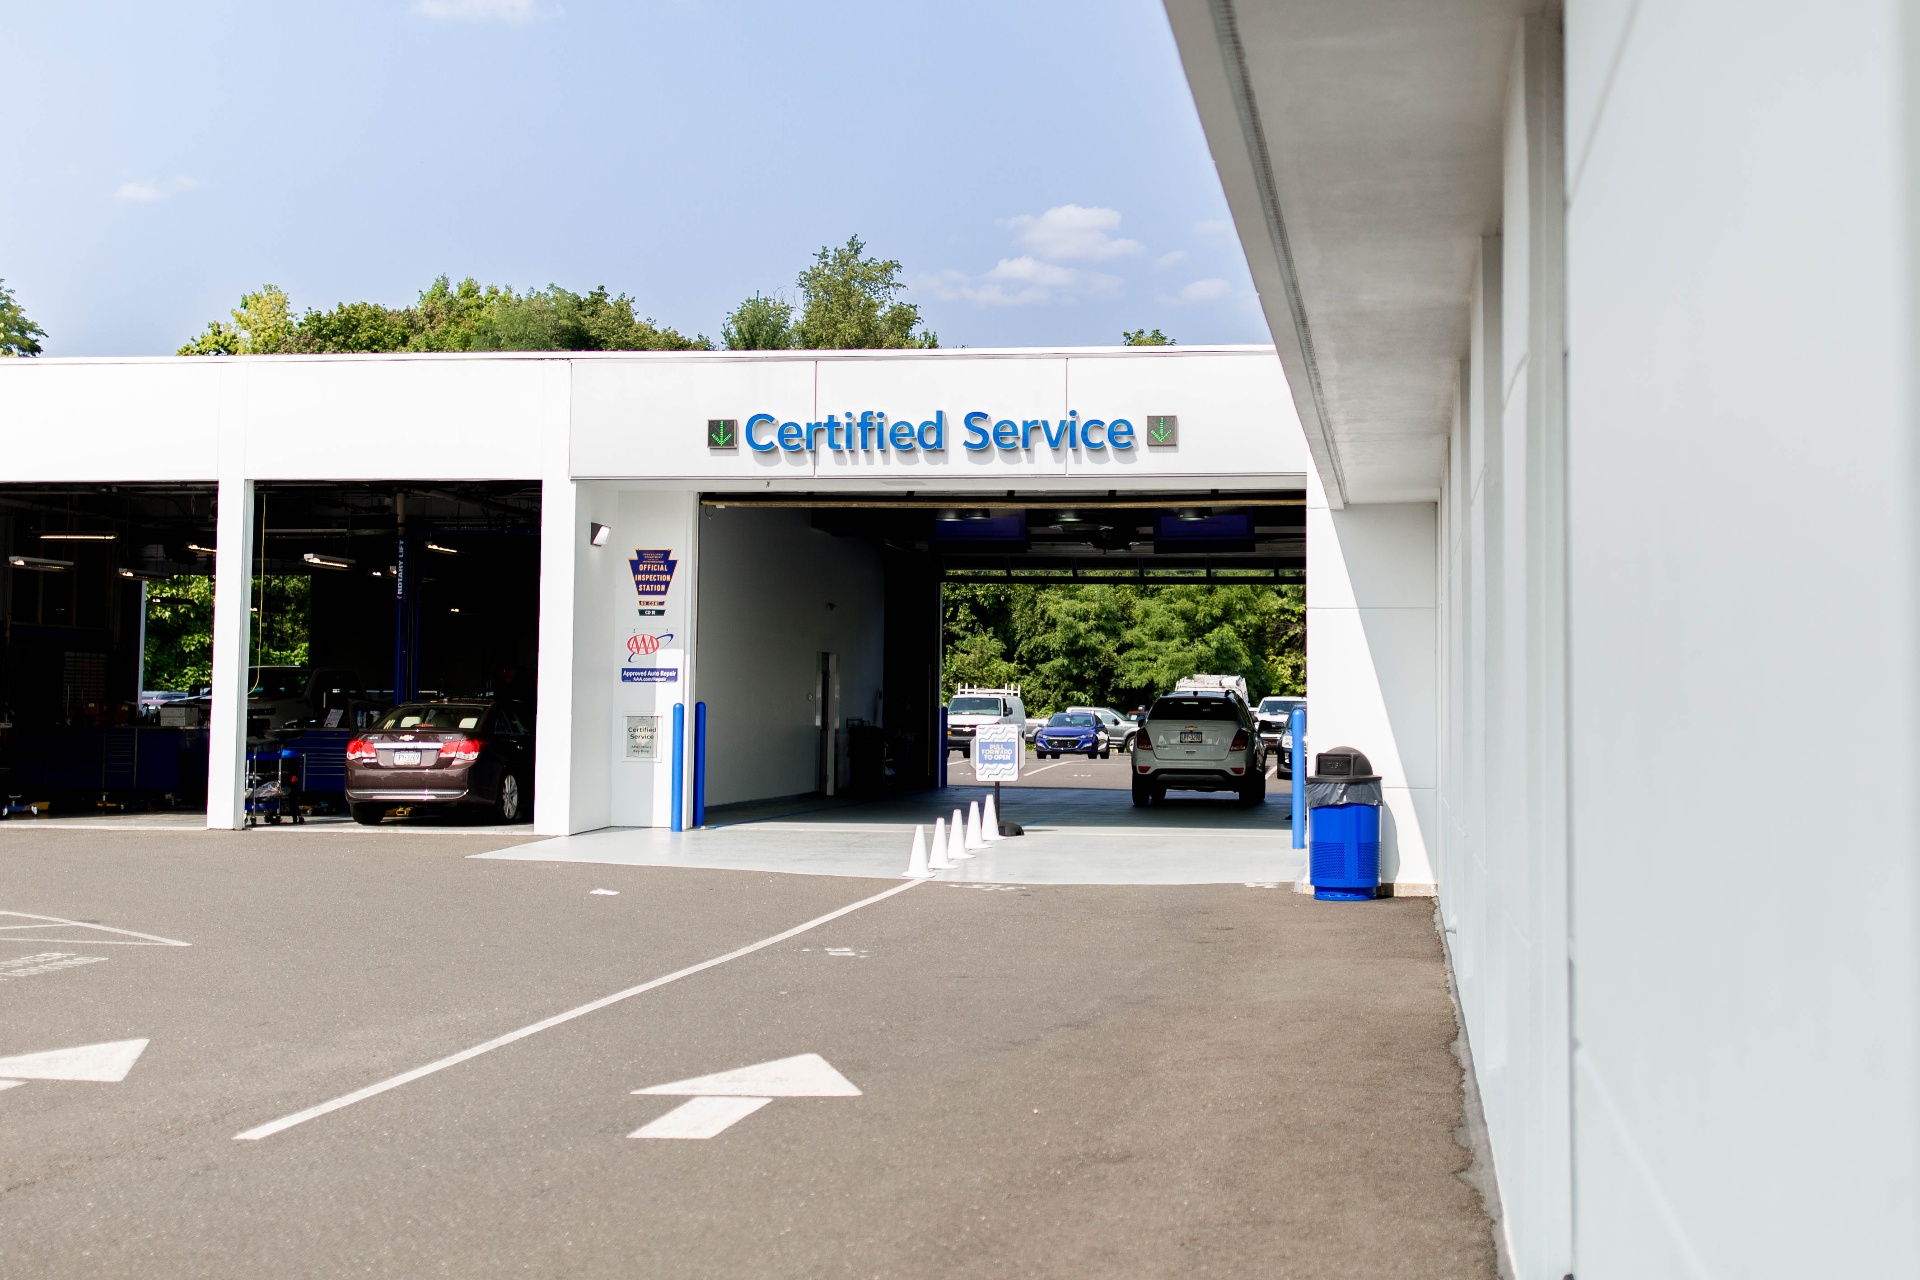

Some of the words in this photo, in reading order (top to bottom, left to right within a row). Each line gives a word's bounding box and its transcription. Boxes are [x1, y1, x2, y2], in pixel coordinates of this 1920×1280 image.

[745, 410, 943, 451] Certified
[963, 410, 1134, 451] Service
[630, 635, 658, 655] AAA
[623, 670, 647, 678] Approved
